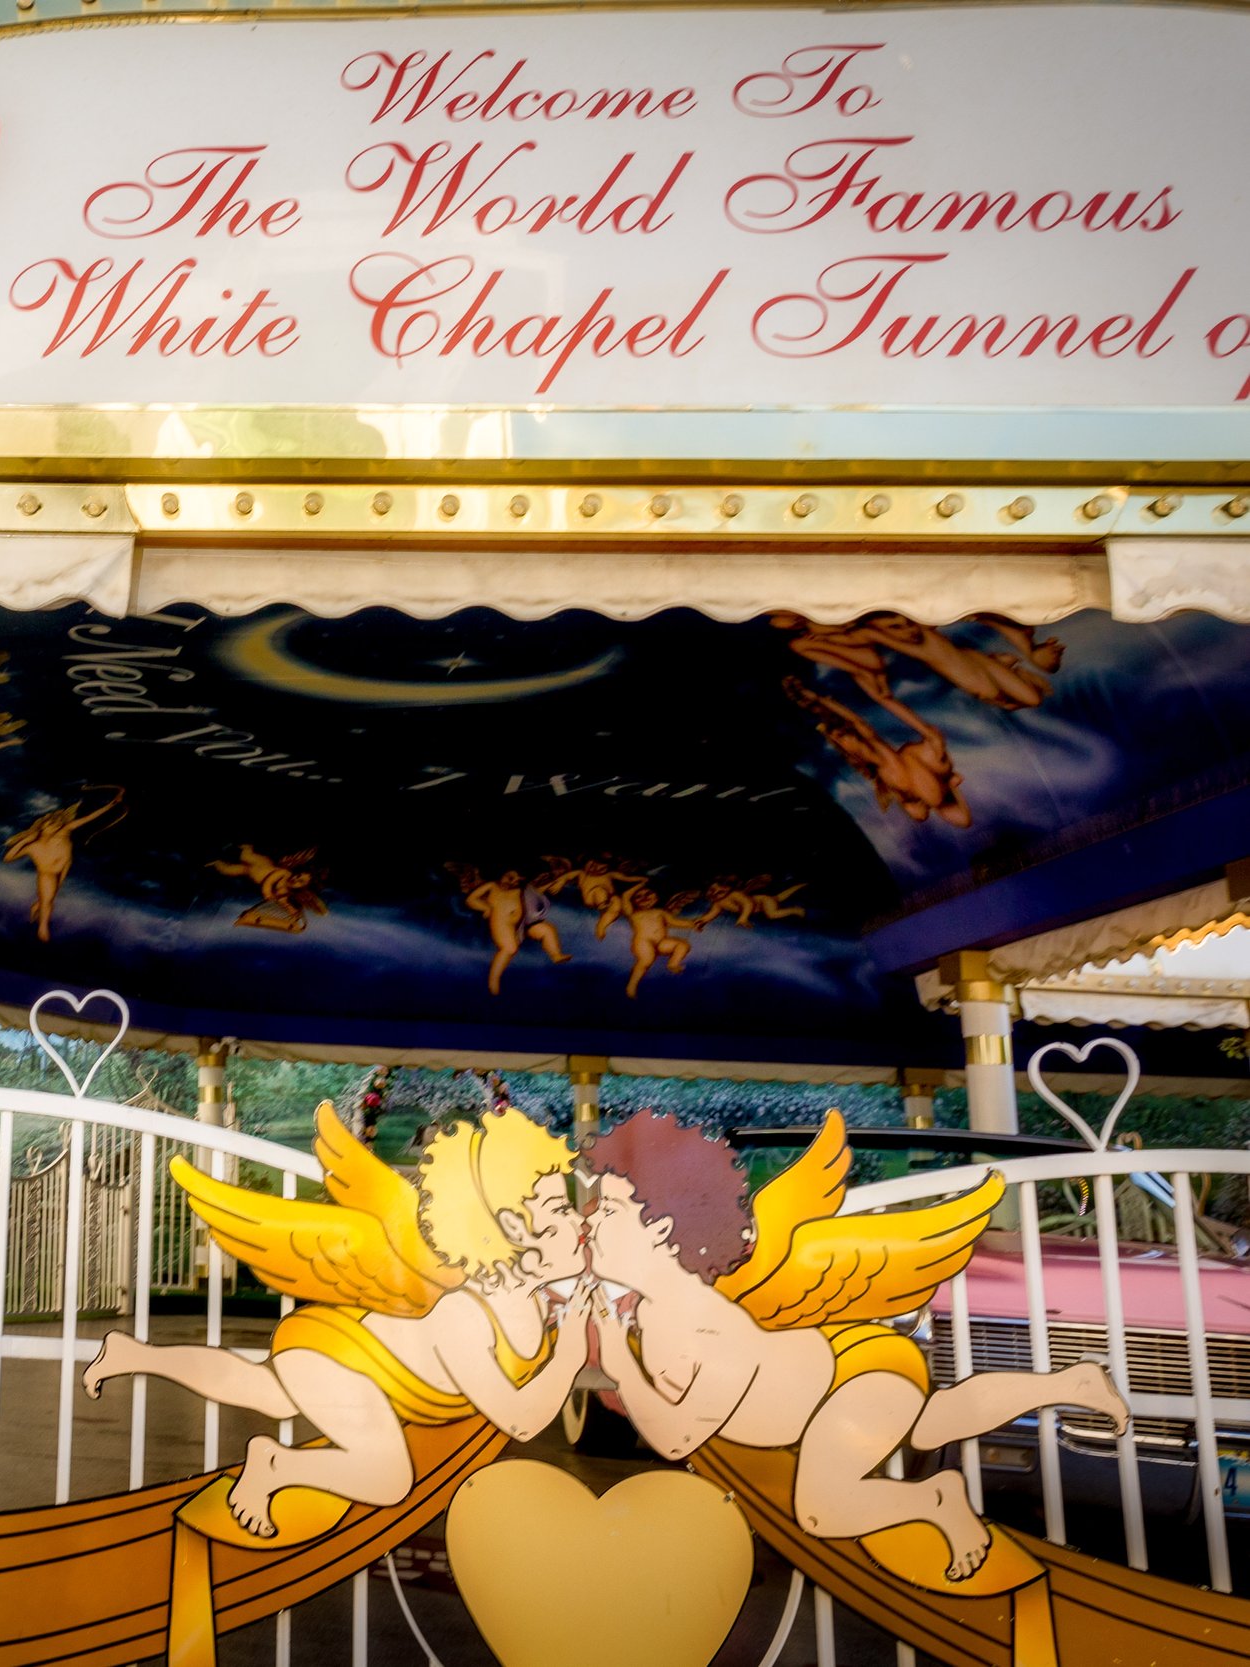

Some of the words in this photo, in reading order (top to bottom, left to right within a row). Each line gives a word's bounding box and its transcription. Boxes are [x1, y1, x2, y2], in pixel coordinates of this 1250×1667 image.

[340, 49, 696, 126] Welcome
[731, 42, 886, 118] To
[82, 144, 302, 239] The
[345, 140, 695, 240] World
[723, 134, 1182, 234] Famous
[8, 256, 300, 360] White
[348, 251, 732, 395] Chapel
[750, 251, 1199, 360] Tunnel
[61, 623, 218, 715] Need
